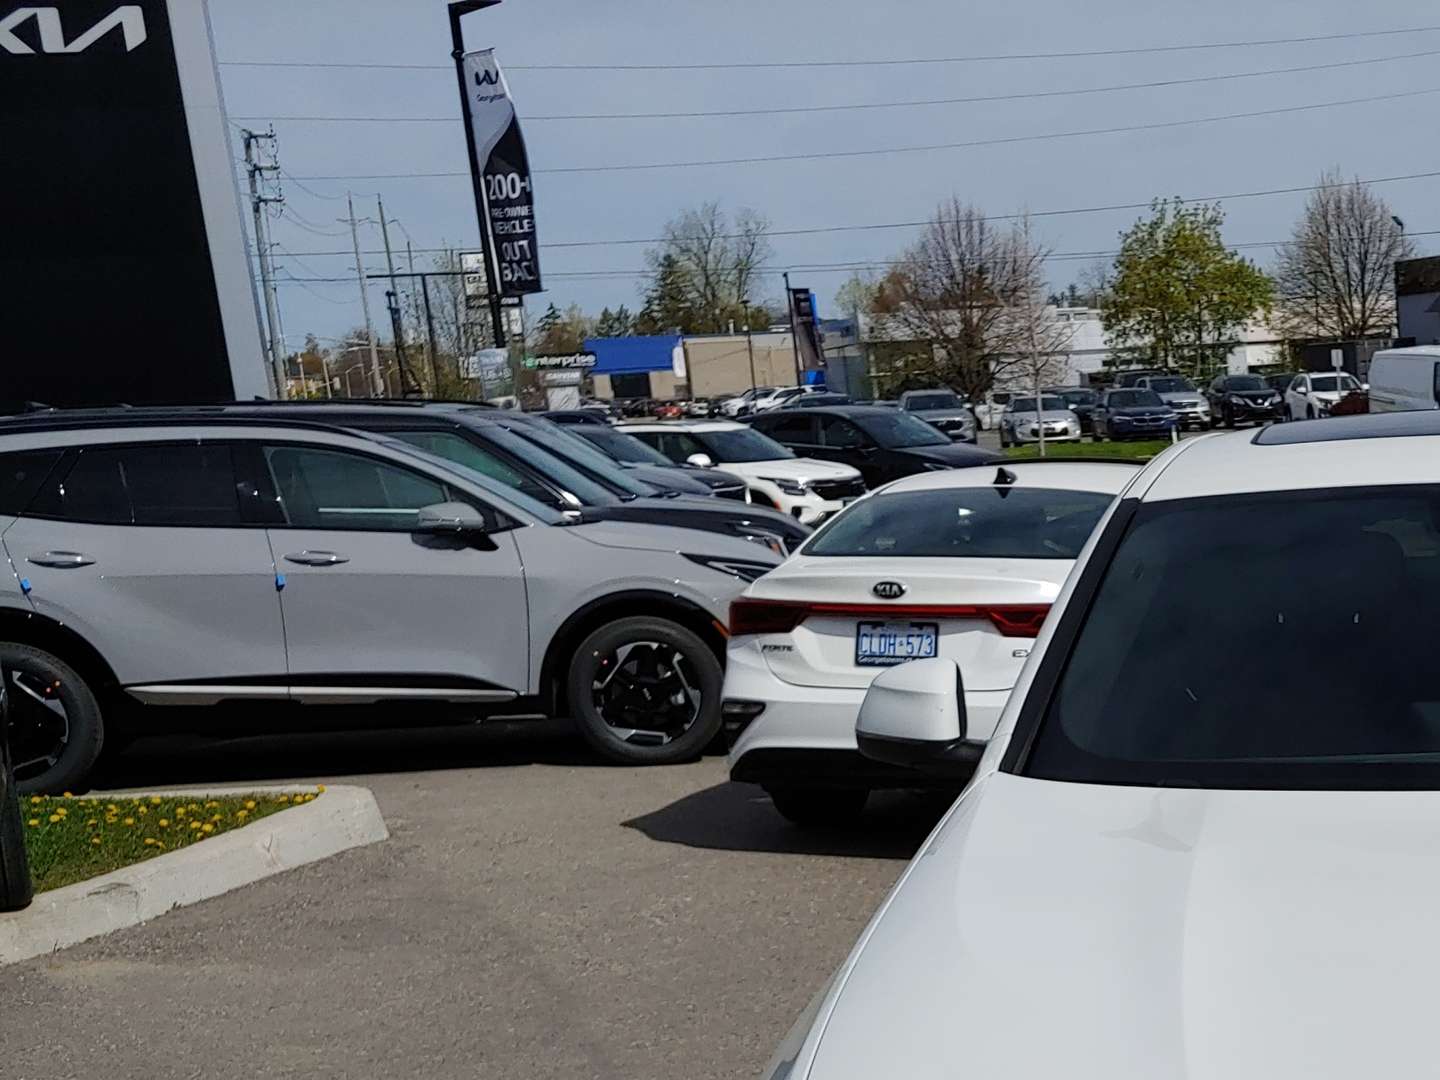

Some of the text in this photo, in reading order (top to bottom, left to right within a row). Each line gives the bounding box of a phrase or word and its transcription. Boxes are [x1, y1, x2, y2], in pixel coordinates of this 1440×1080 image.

[501, 240, 532, 261] OUT
[501, 261, 537, 282] BAC
[876, 583, 902, 596] KIA
[906, 633, 934, 656] 573
